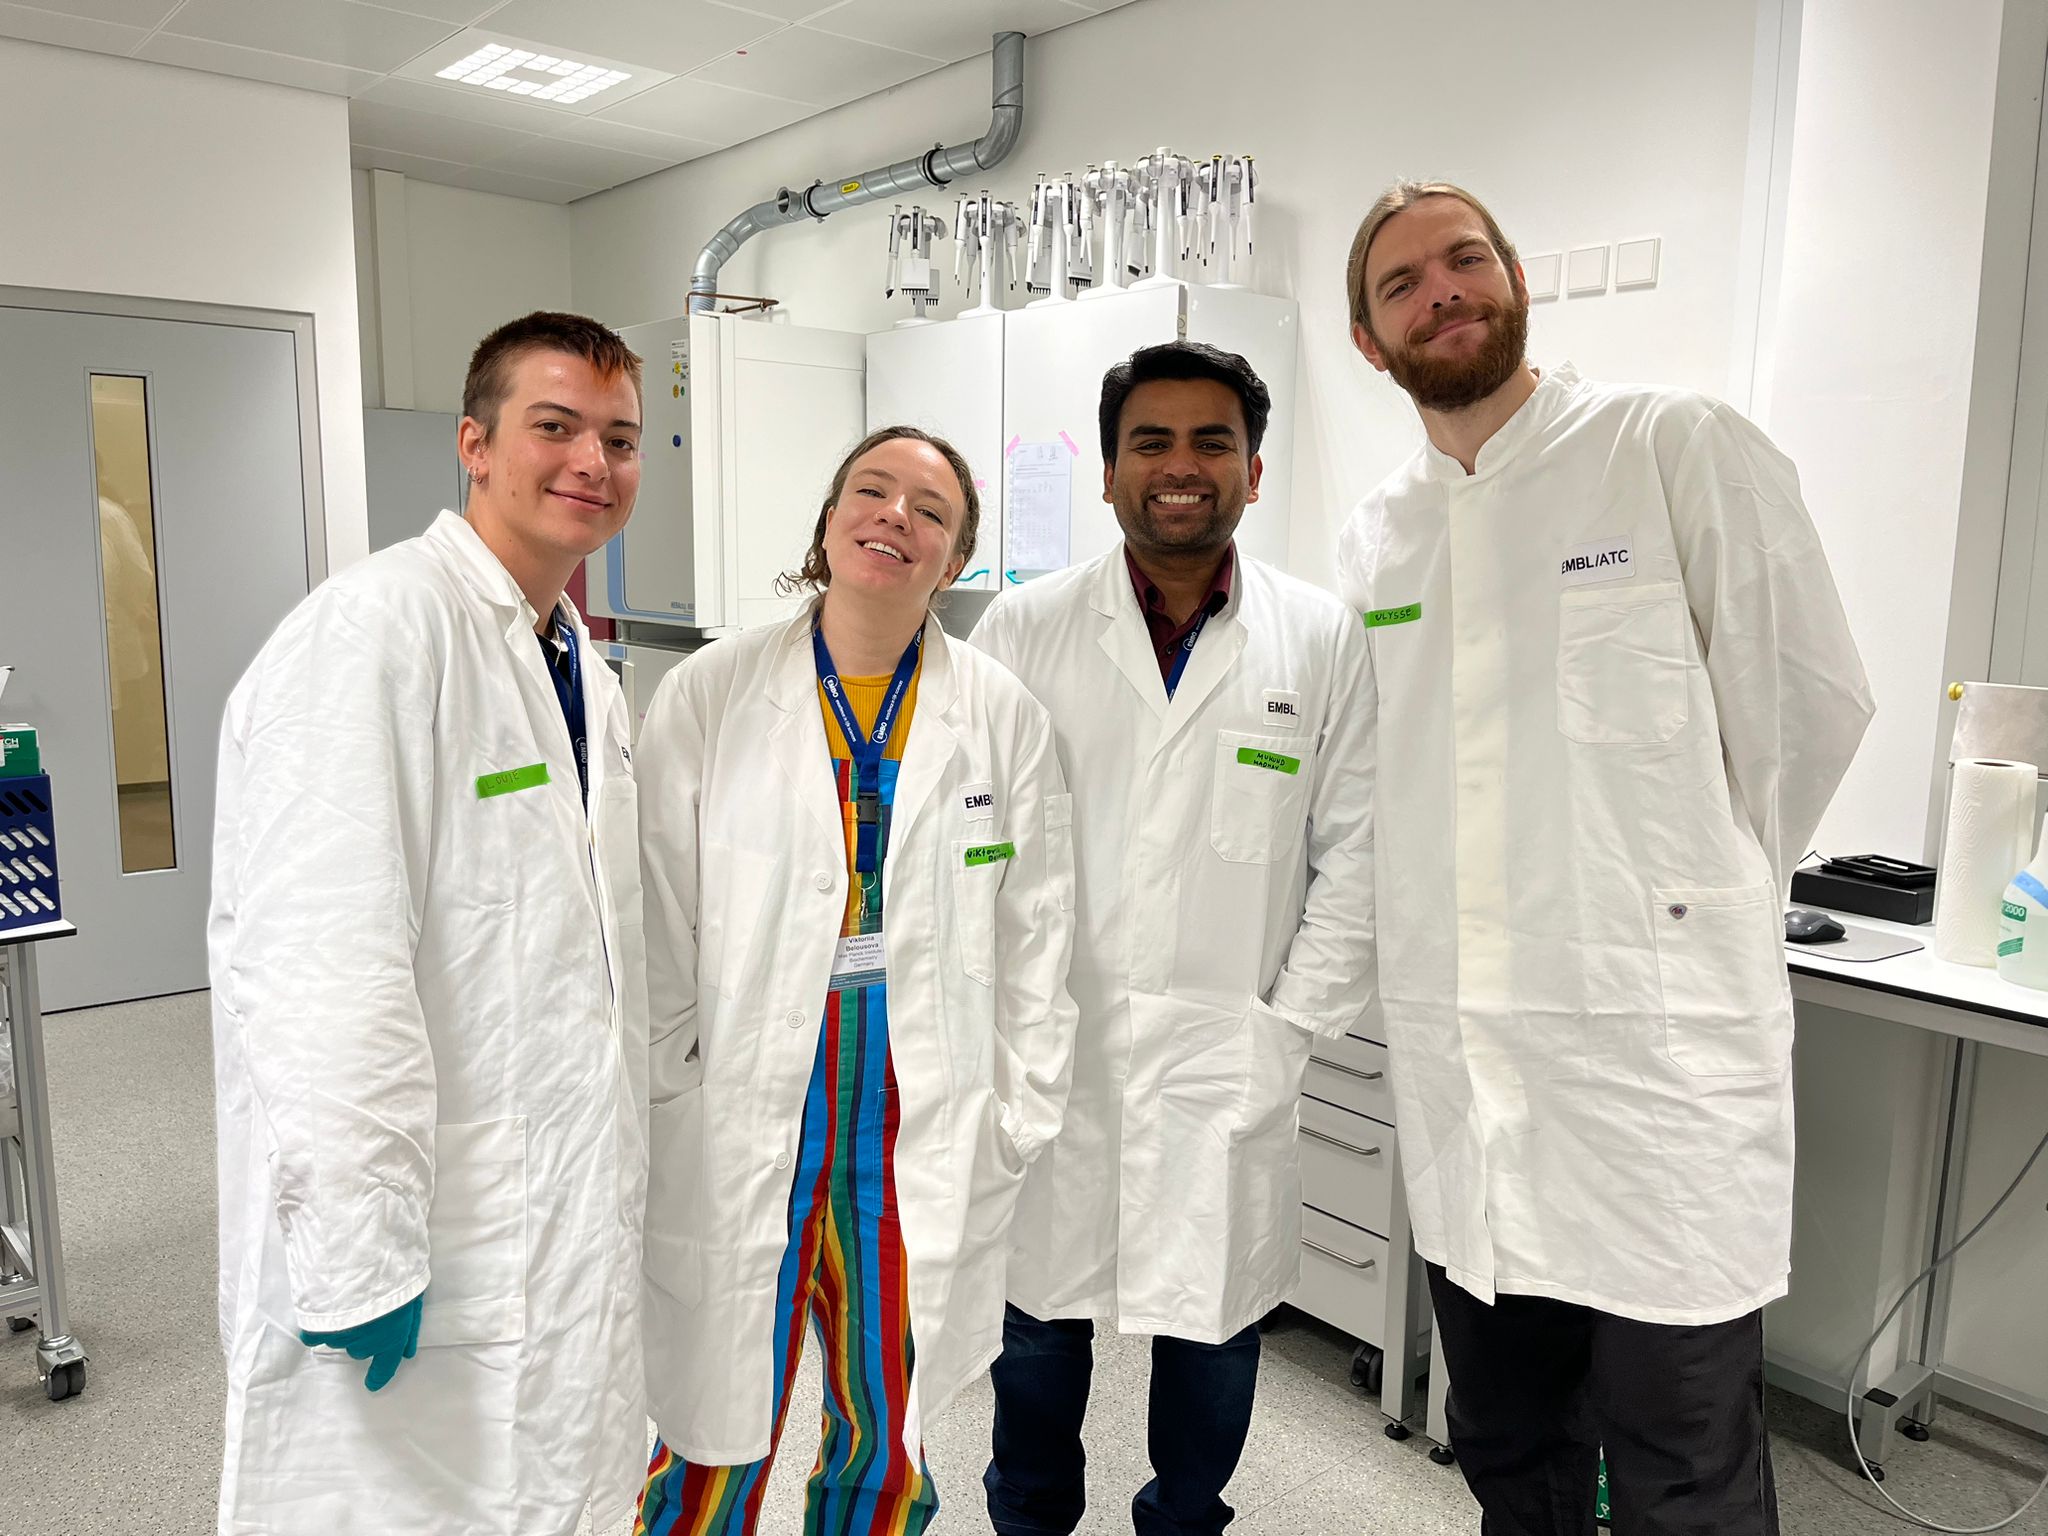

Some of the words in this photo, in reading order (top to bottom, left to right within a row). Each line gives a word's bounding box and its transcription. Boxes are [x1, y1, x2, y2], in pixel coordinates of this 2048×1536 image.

[1375, 607, 1412, 621] ULYSSE
[1267, 701, 1297, 715] EMBL
[1257, 752, 1286, 766] MUKUND
